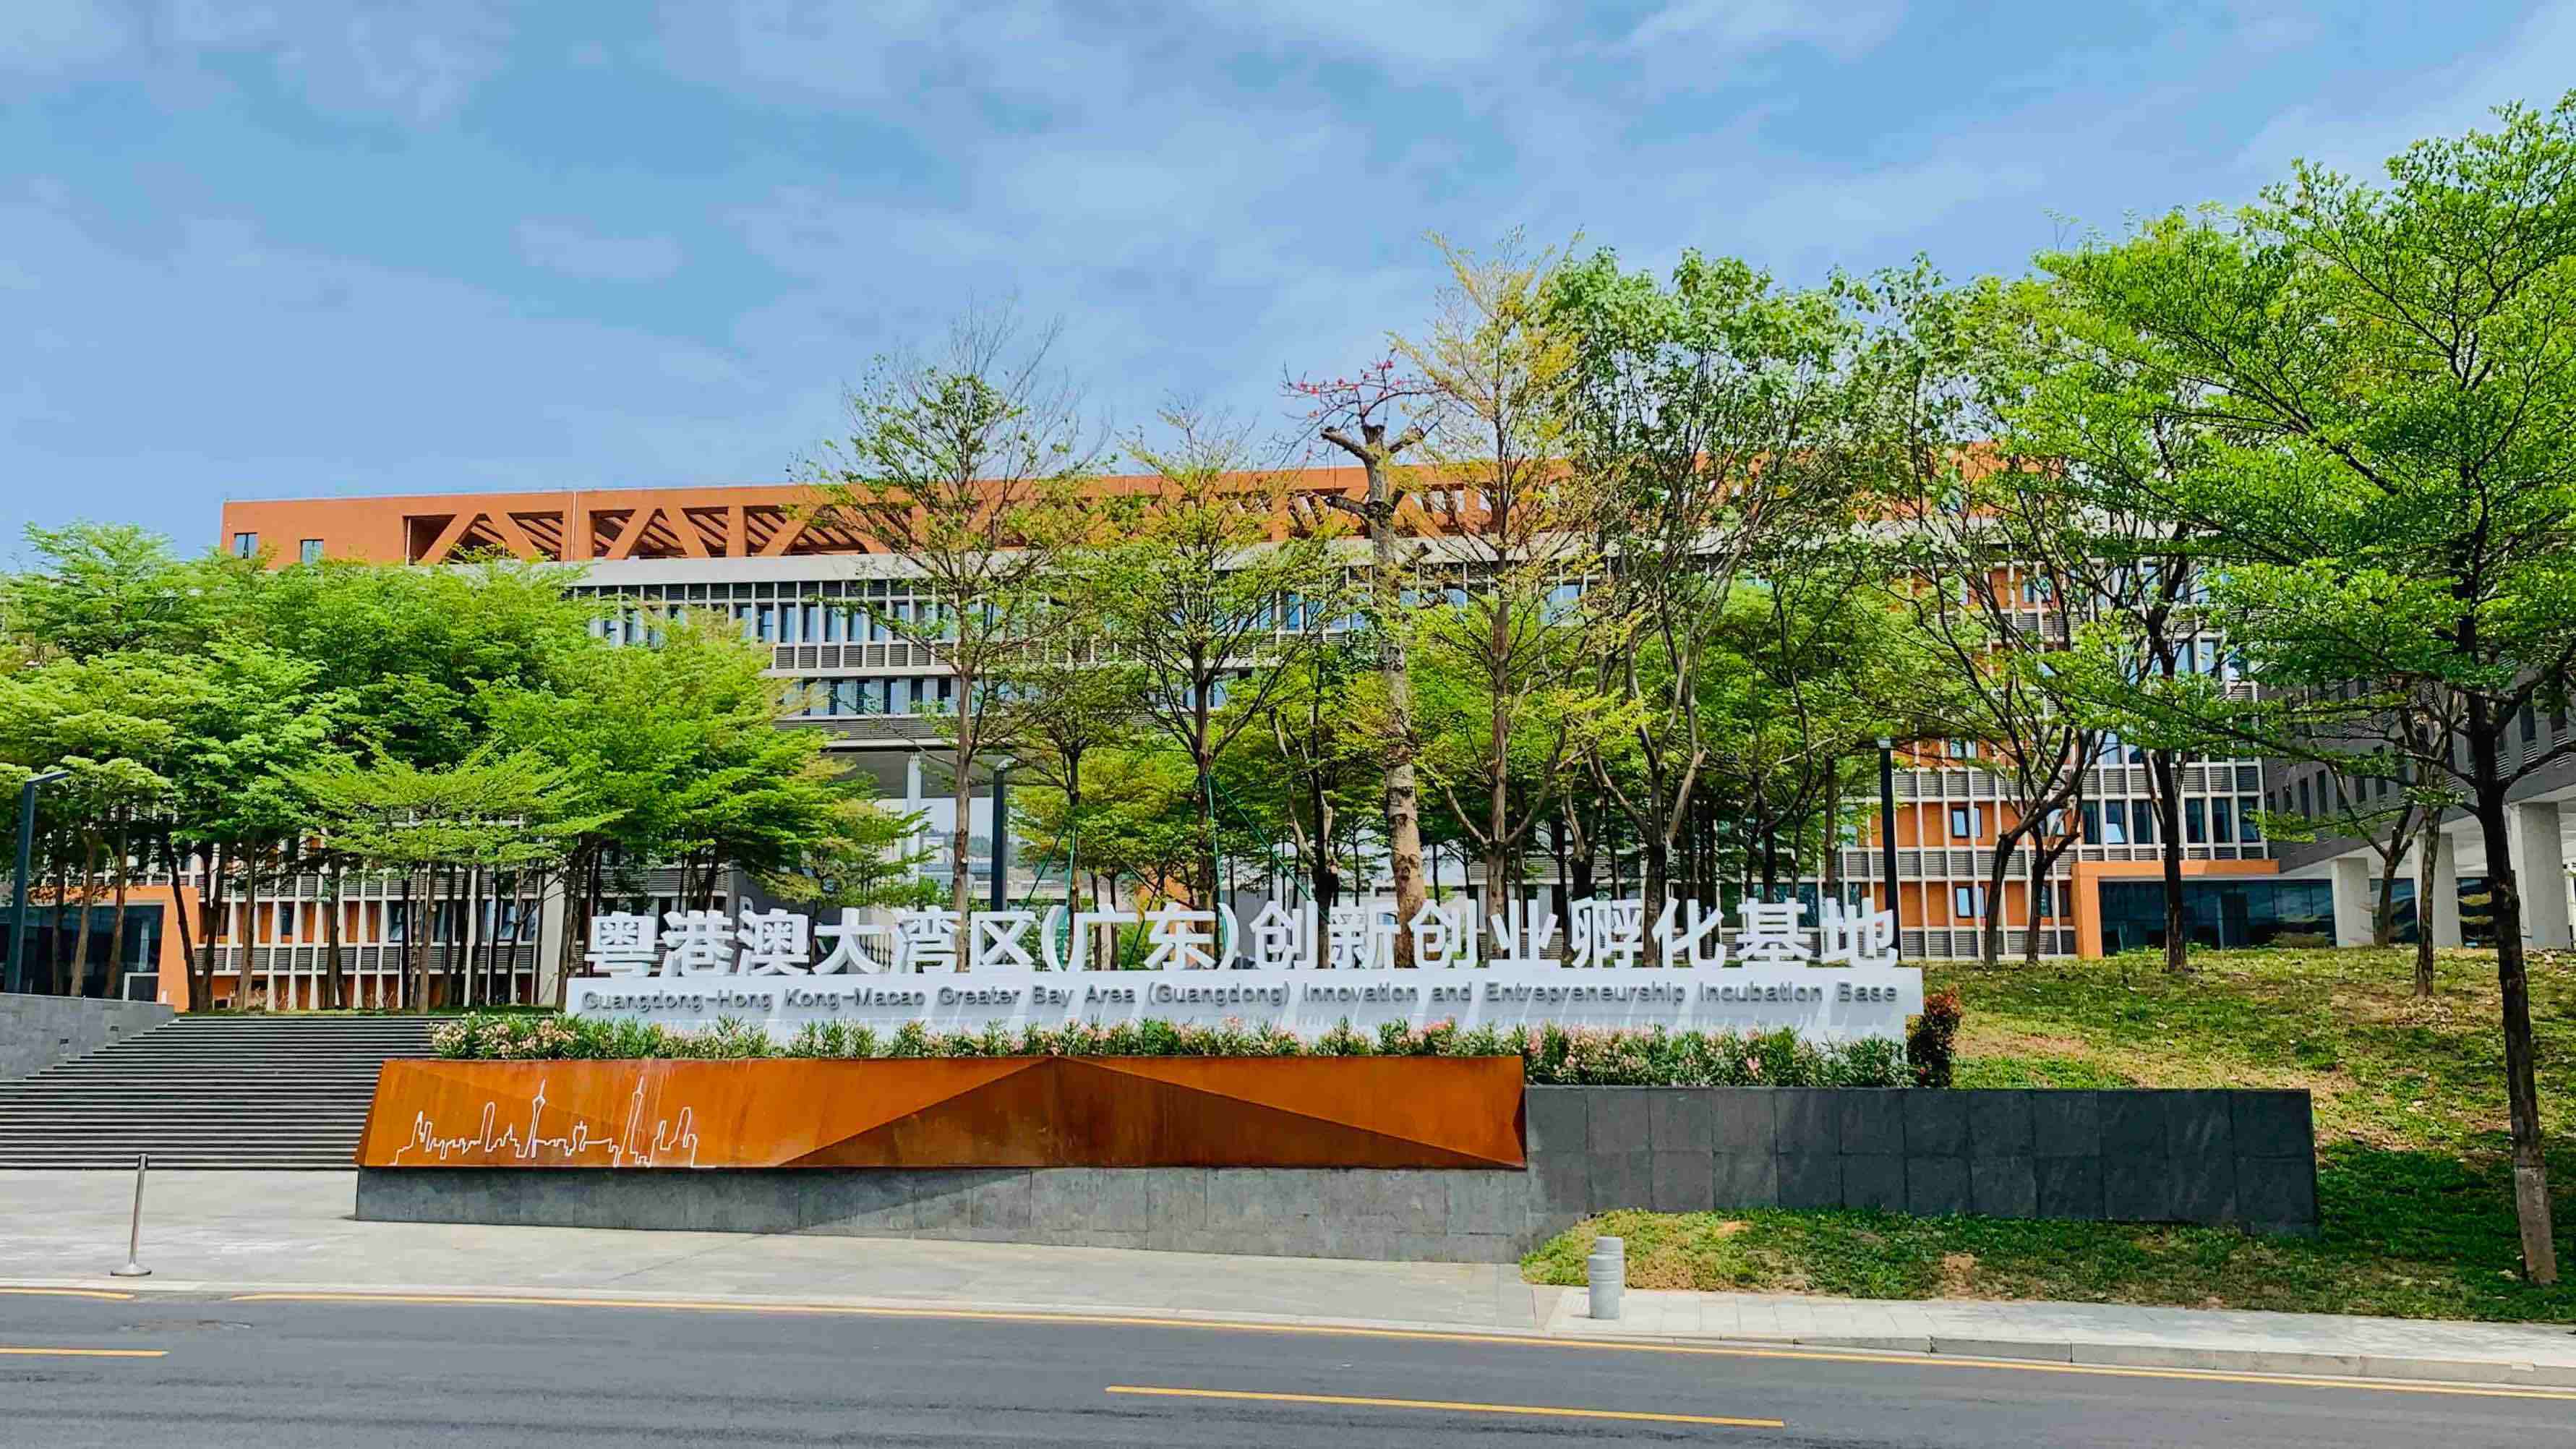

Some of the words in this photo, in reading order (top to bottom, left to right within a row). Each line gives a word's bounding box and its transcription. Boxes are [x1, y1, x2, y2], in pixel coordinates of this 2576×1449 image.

[581, 988, 773, 1012] Guangdong-Hong
[784, 986, 925, 1009] Kong-Macao
[938, 985, 1022, 1006] Greater
[1032, 985, 1073, 1007] Bay
[1084, 983, 1136, 1003] Area
[1147, 981, 1291, 1007] (Guangdong)
[1302, 982, 1418, 1002] Innovation
[1432, 982, 1472, 1001] and
[1486, 981, 1686, 1006] Entrepreneurship
[1699, 981, 1823, 1002] Incubation
[1837, 981, 1898, 1002] Base
